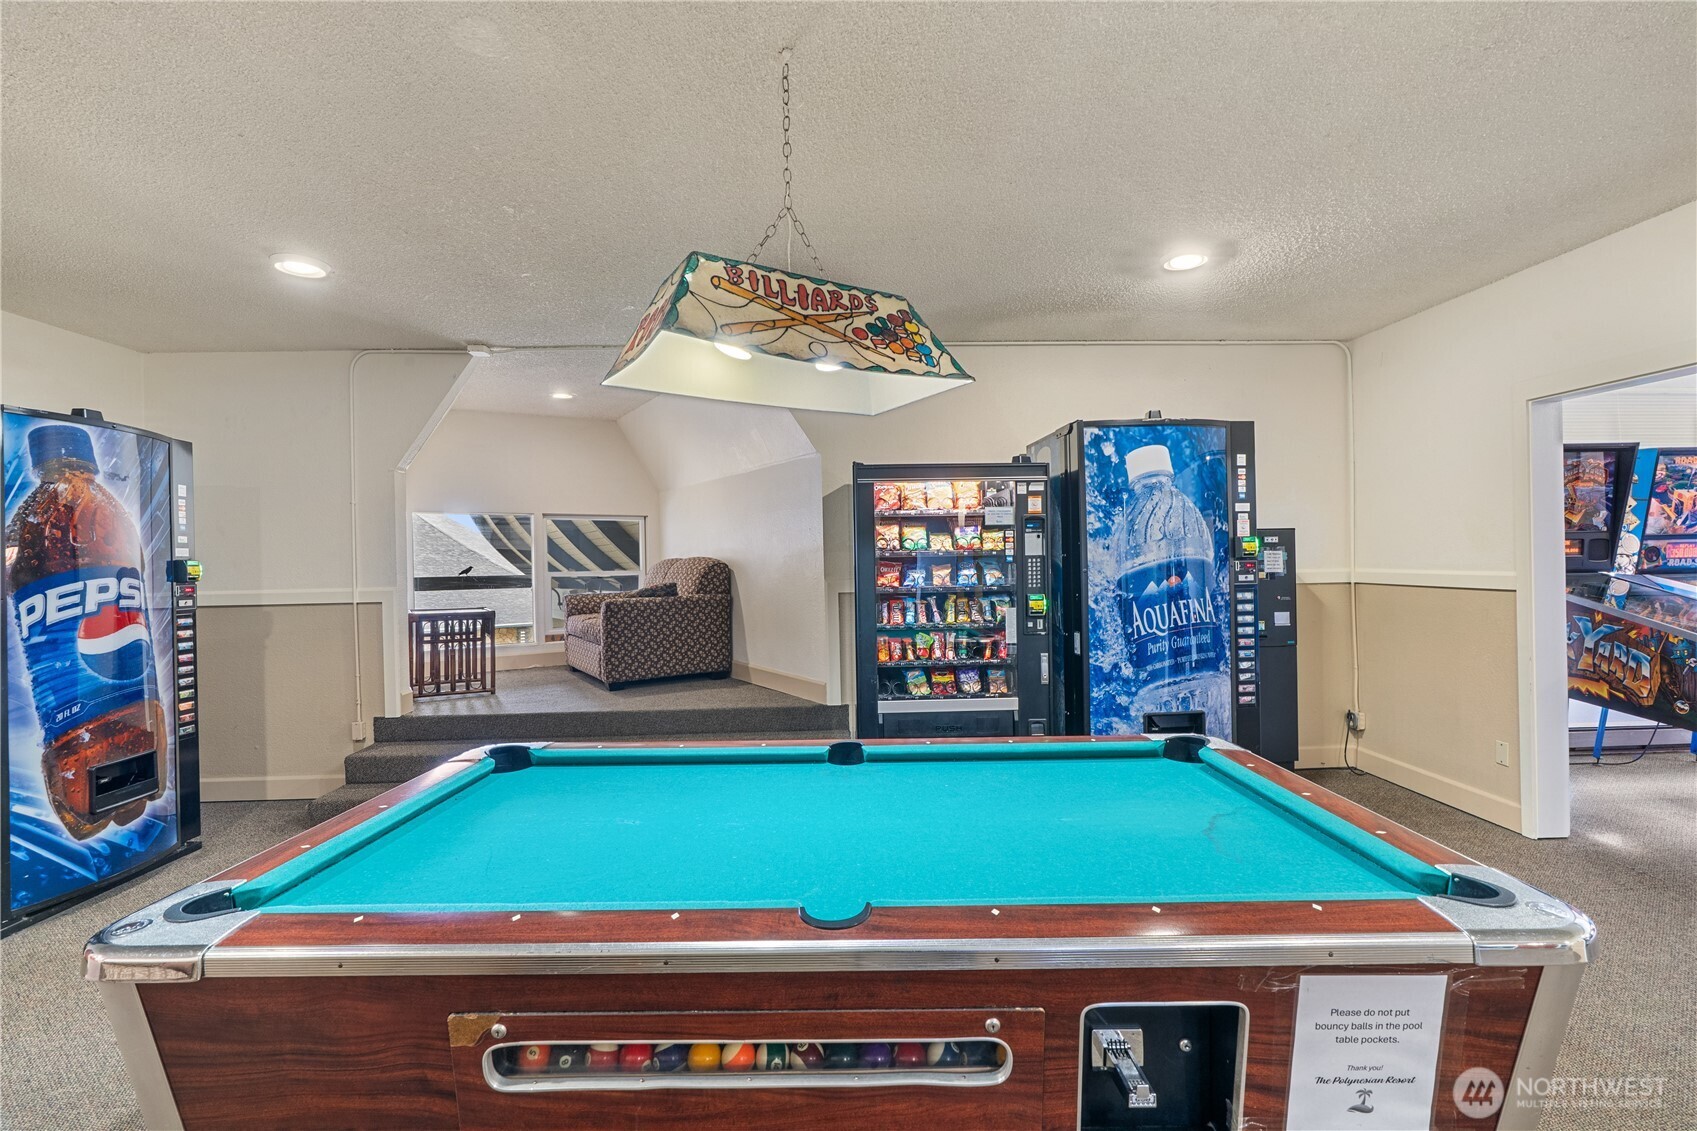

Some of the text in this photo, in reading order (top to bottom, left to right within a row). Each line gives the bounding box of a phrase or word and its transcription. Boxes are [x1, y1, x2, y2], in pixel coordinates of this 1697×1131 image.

[723, 266, 879, 312] BILLIARDS
[1132, 586, 1217, 639] AQUAFINA
[1147, 630, 1211, 656] Purity Guaranteed
[1572, 615, 1651, 698] YARD
[1330, 1008, 1410, 1018] Please do not put
[1315, 1022, 1423, 1032] bouncy balls in the pool
[1335, 1036, 1400, 1045] table pockets.
[1315, 1076, 1416, 1086] The Polynesian Resort
